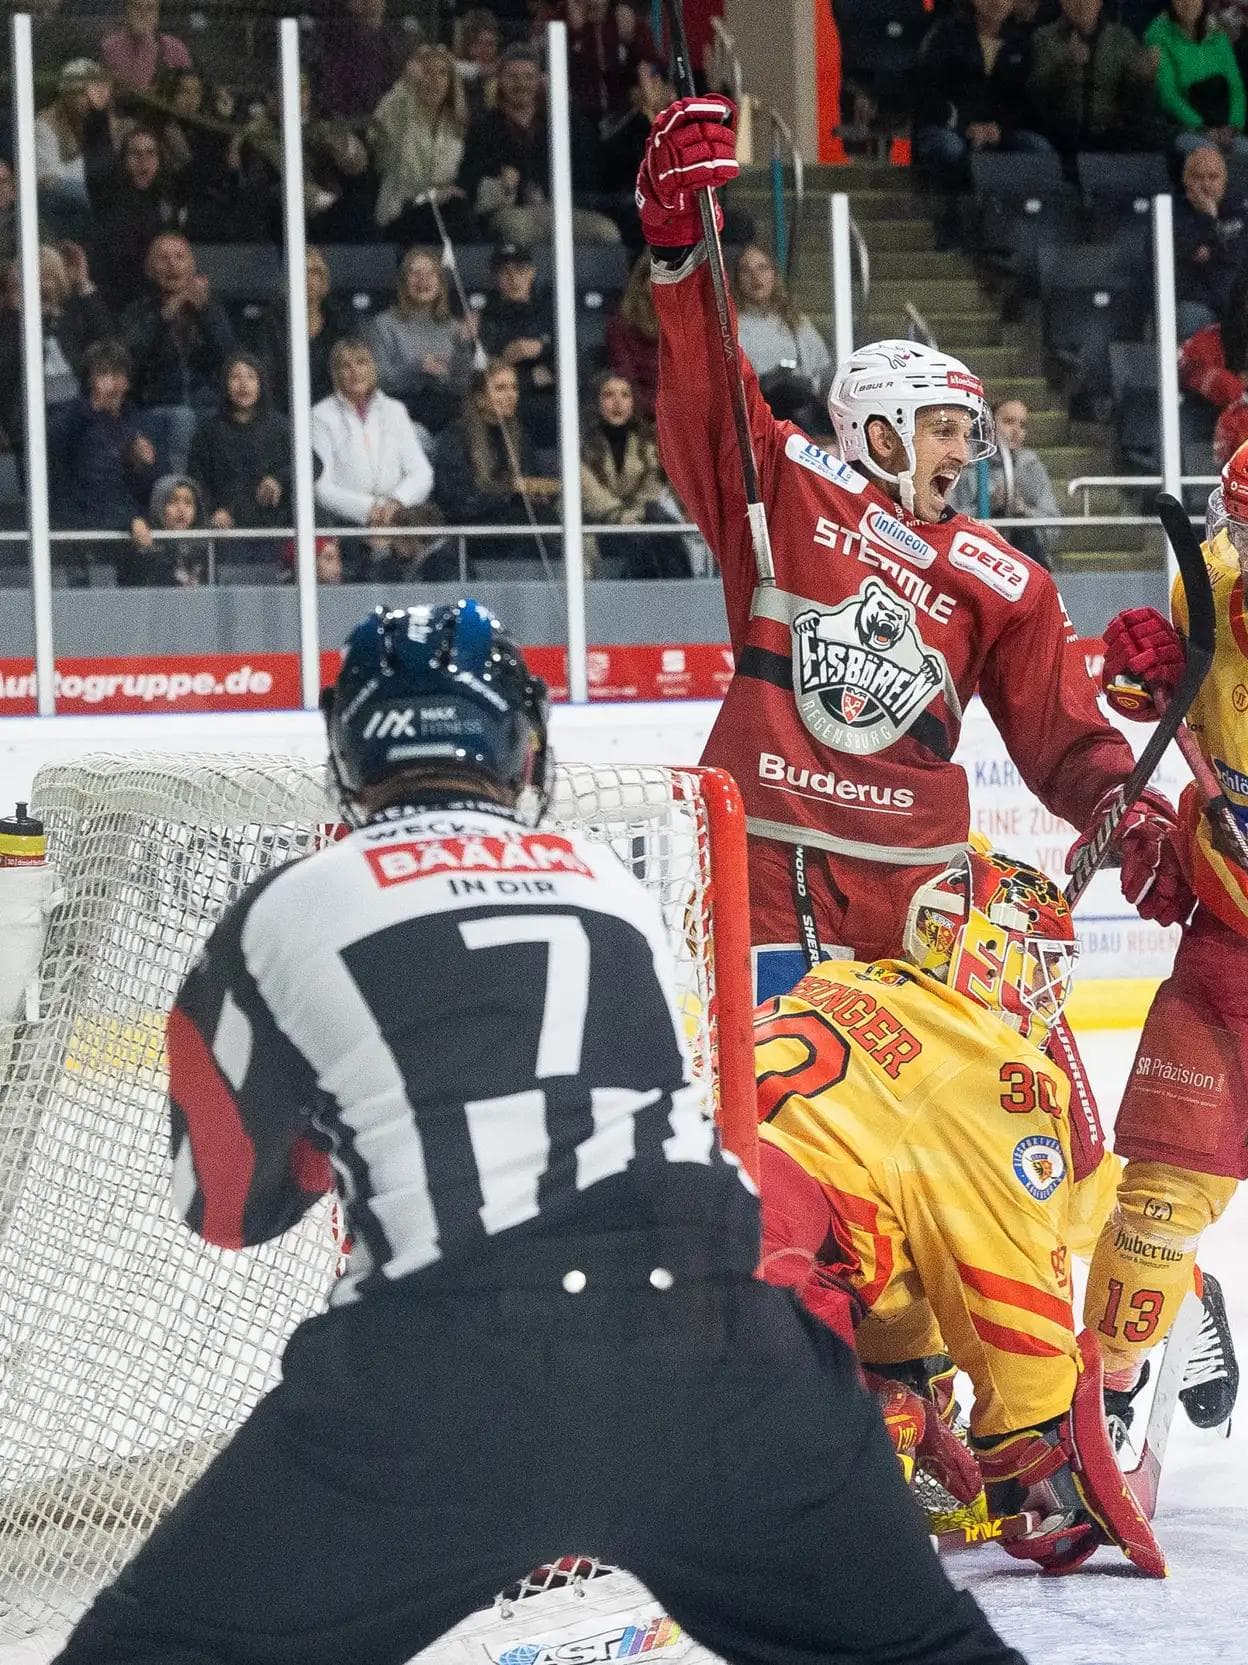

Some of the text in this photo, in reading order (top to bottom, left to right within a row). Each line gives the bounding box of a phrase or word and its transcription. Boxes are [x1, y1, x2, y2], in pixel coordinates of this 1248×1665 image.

[874, 511, 929, 557] infineon
[800, 627, 934, 722] EISBÄREN
[801, 699, 893, 749] REGENSBURG
[758, 752, 915, 808] Buderus
[376, 832, 586, 881] BÄÄÄM
[449, 879, 558, 896] IN DIR
[457, 914, 591, 1079] 7
[1136, 1057, 1214, 1090] SR Präzision
[1098, 1278, 1166, 1342] 13
